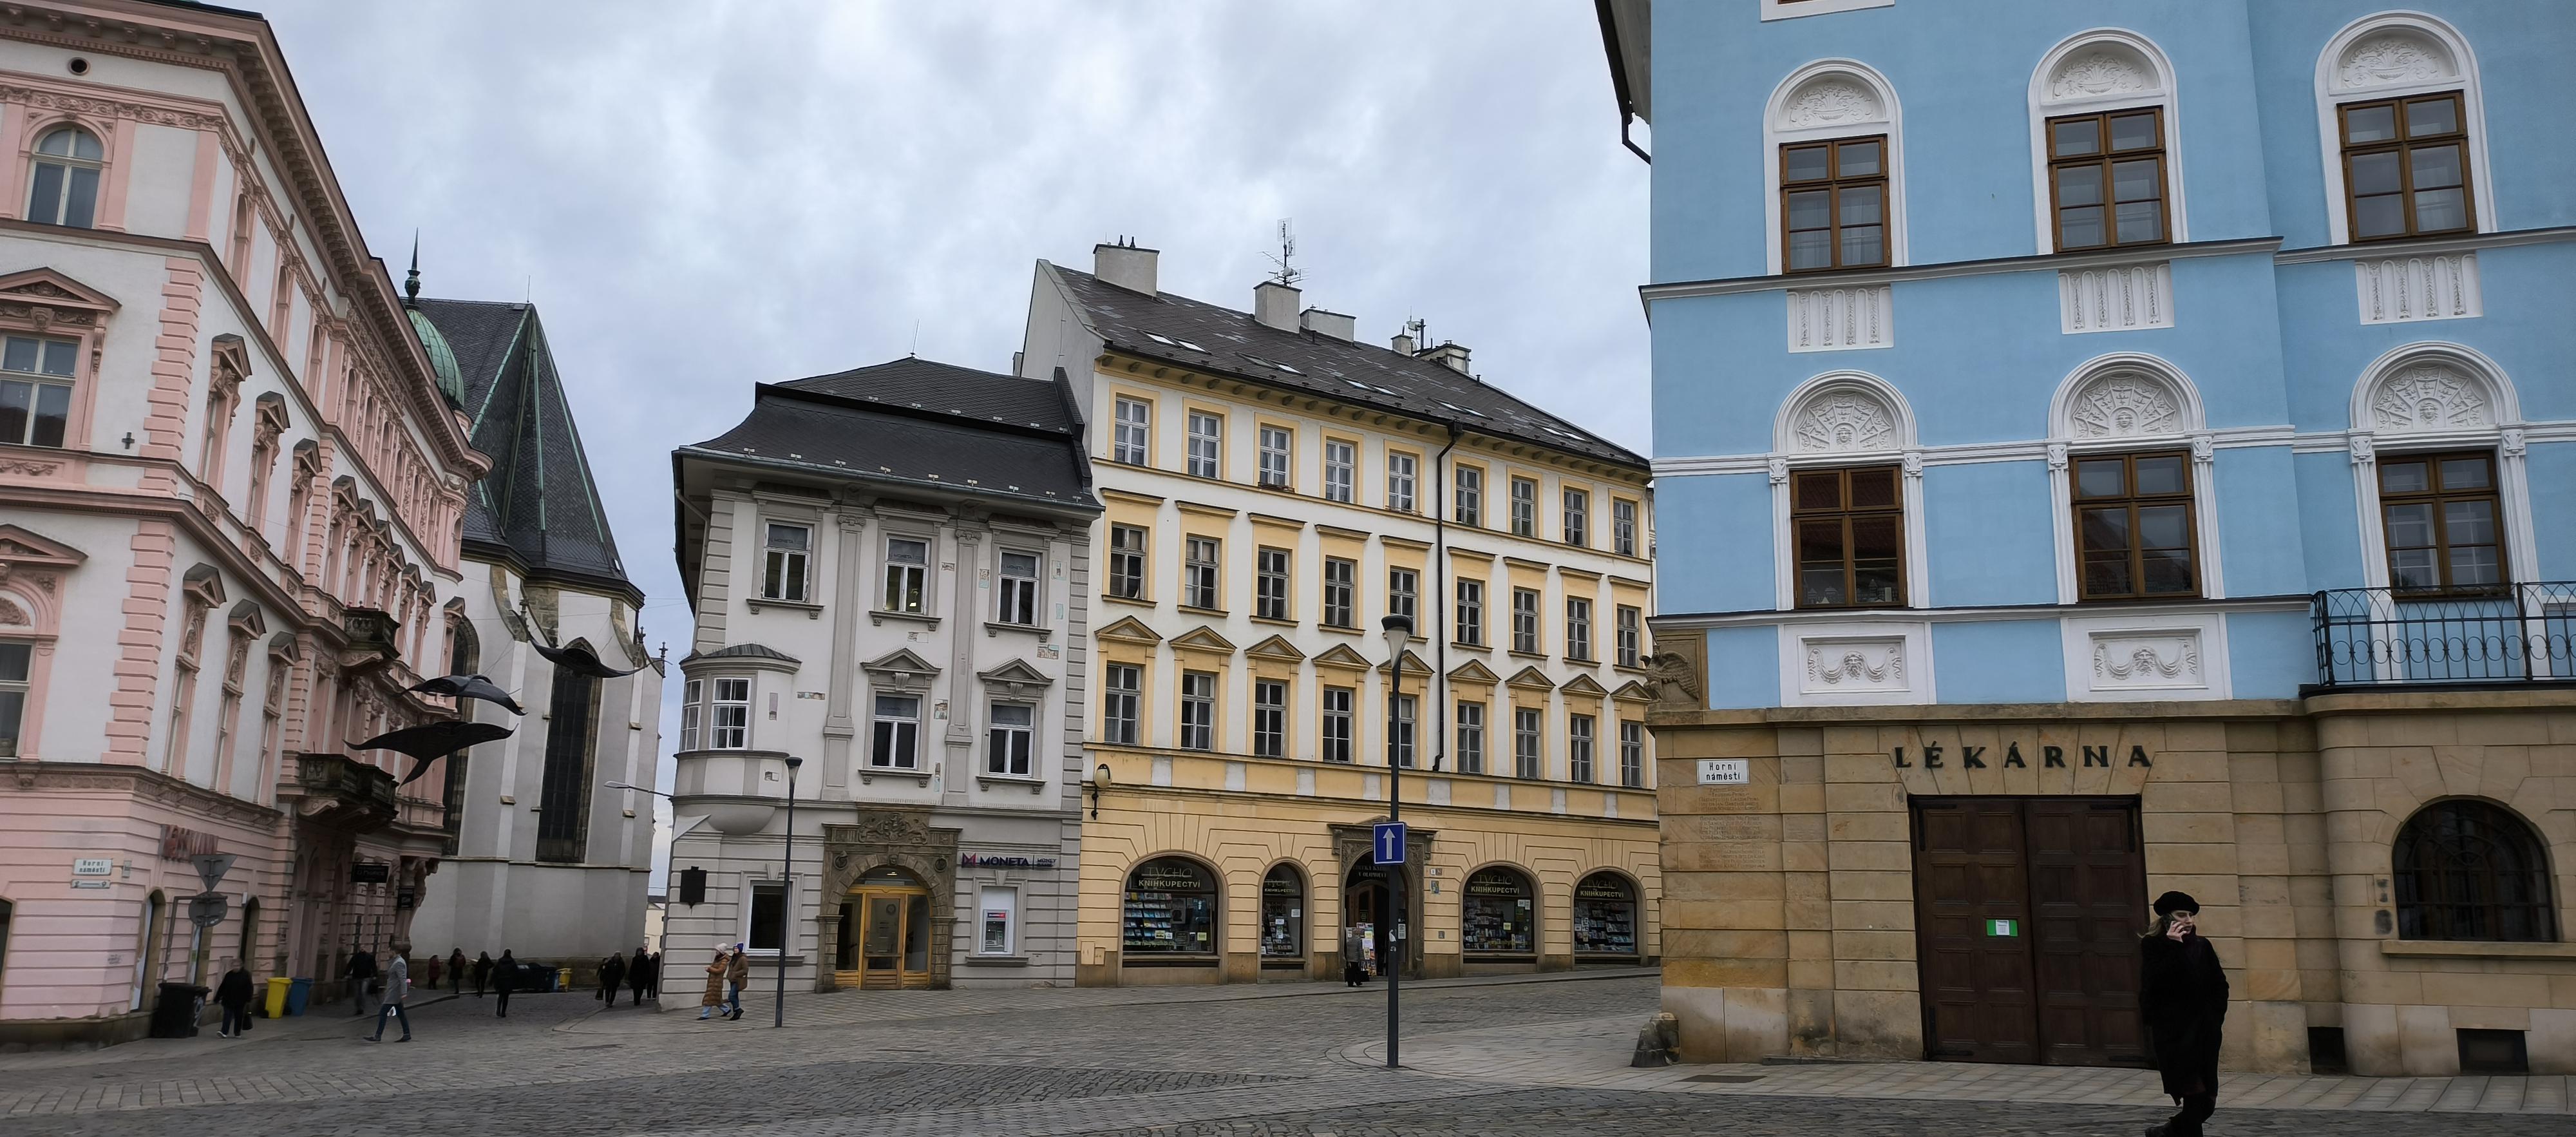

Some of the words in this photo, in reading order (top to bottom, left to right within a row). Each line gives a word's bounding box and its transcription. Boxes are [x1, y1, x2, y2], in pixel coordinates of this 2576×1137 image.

[1894, 741, 2151, 769] LÉKÁRNA
[1709, 761, 1737, 770] Horní
[1706, 771, 1740, 781] náměstí
[980, 856, 1030, 866] MONETA
[1138, 879, 1200, 888] KNIHKUPECTVÍ
[1471, 886, 1520, 894] KNIHKUPECTVÍ
